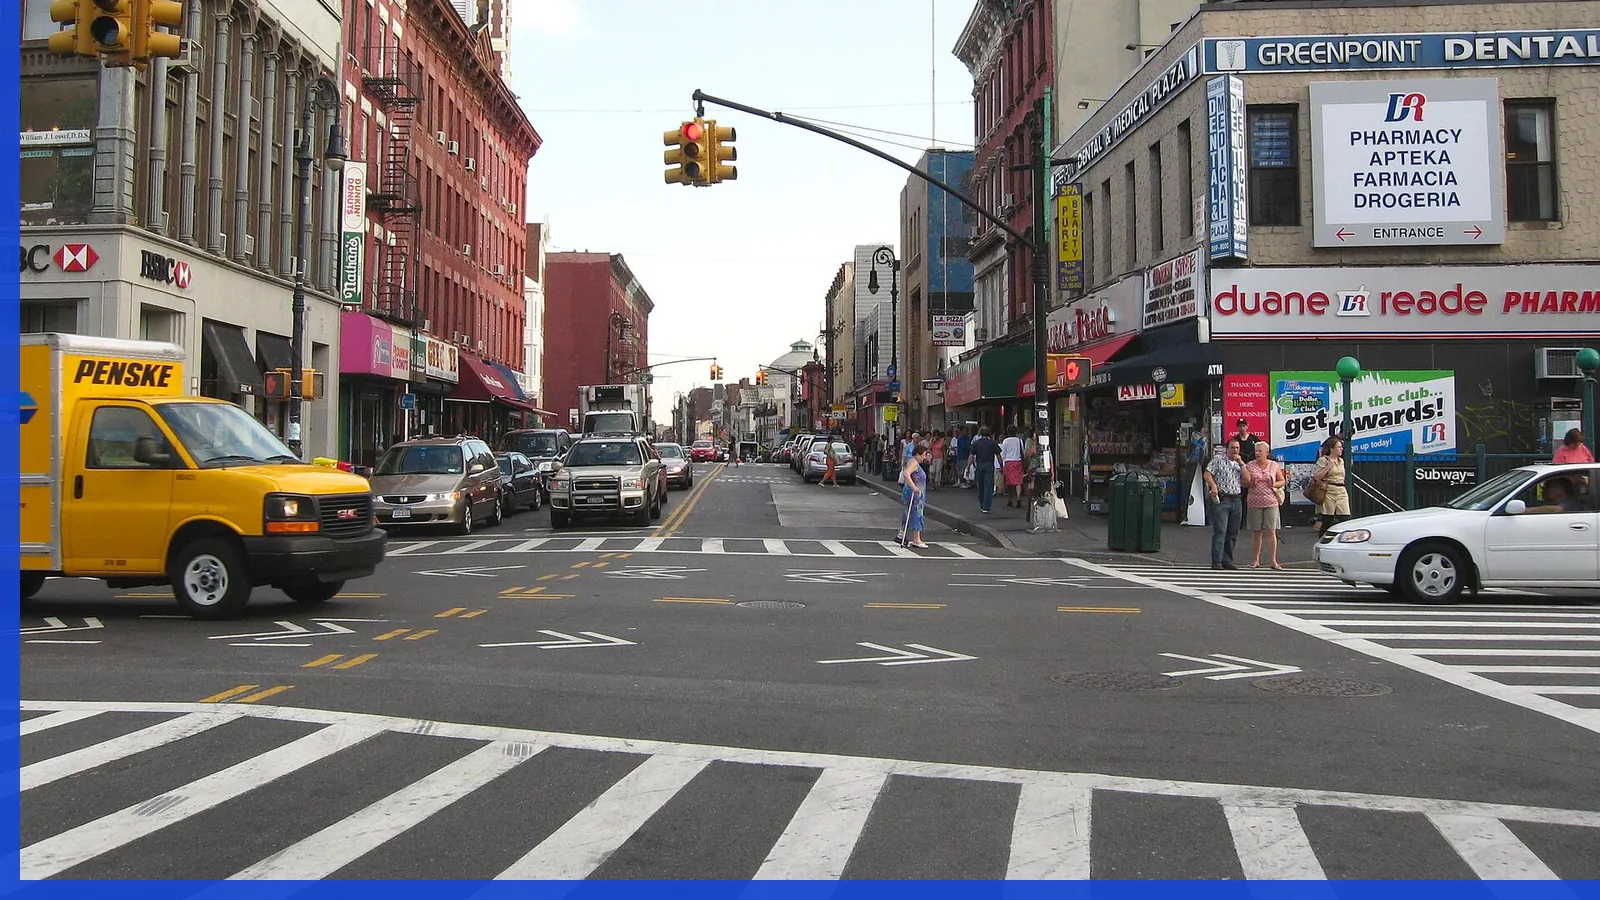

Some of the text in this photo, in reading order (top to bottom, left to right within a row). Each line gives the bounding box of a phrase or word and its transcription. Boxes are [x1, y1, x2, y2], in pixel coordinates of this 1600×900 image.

[1258, 35, 1600, 66] GREENPOINT DENTAL
[1077, 61, 1185, 170] DENTAL & MEDICAL PLAZA
[1384, 92, 1426, 123] DR
[1350, 129, 1462, 146] PHARMACY
[1209, 99, 1217, 203] DENTAL
[1218, 95, 1227, 220] MEDICAL
[1369, 150, 1452, 167] APTEKA
[1353, 171, 1458, 187] FARMACIA
[346, 177, 354, 215] DONUTS
[1061, 185, 1078, 195] SPA
[1354, 192, 1461, 208] DROGERIA
[1211, 224, 1229, 237] PLAZA
[1373, 227, 1444, 239] ENTRANCE
[140, 249, 175, 284] HSBC
[1214, 284, 1330, 316] duane
[1380, 282, 1488, 315] reade
[1503, 291, 1600, 314] PHARM
[73, 359, 174, 388] PENSKE
[1207, 364, 1223, 375] ATM
[1120, 383, 1155, 398] ATM
[1367, 395, 1393, 408] the
[1285, 408, 1327, 440] get
[1422, 421, 1446, 445] DR
[1360, 443, 1369, 452] up
[1370, 437, 1393, 448] today!
[1415, 468, 1467, 483] Subway
